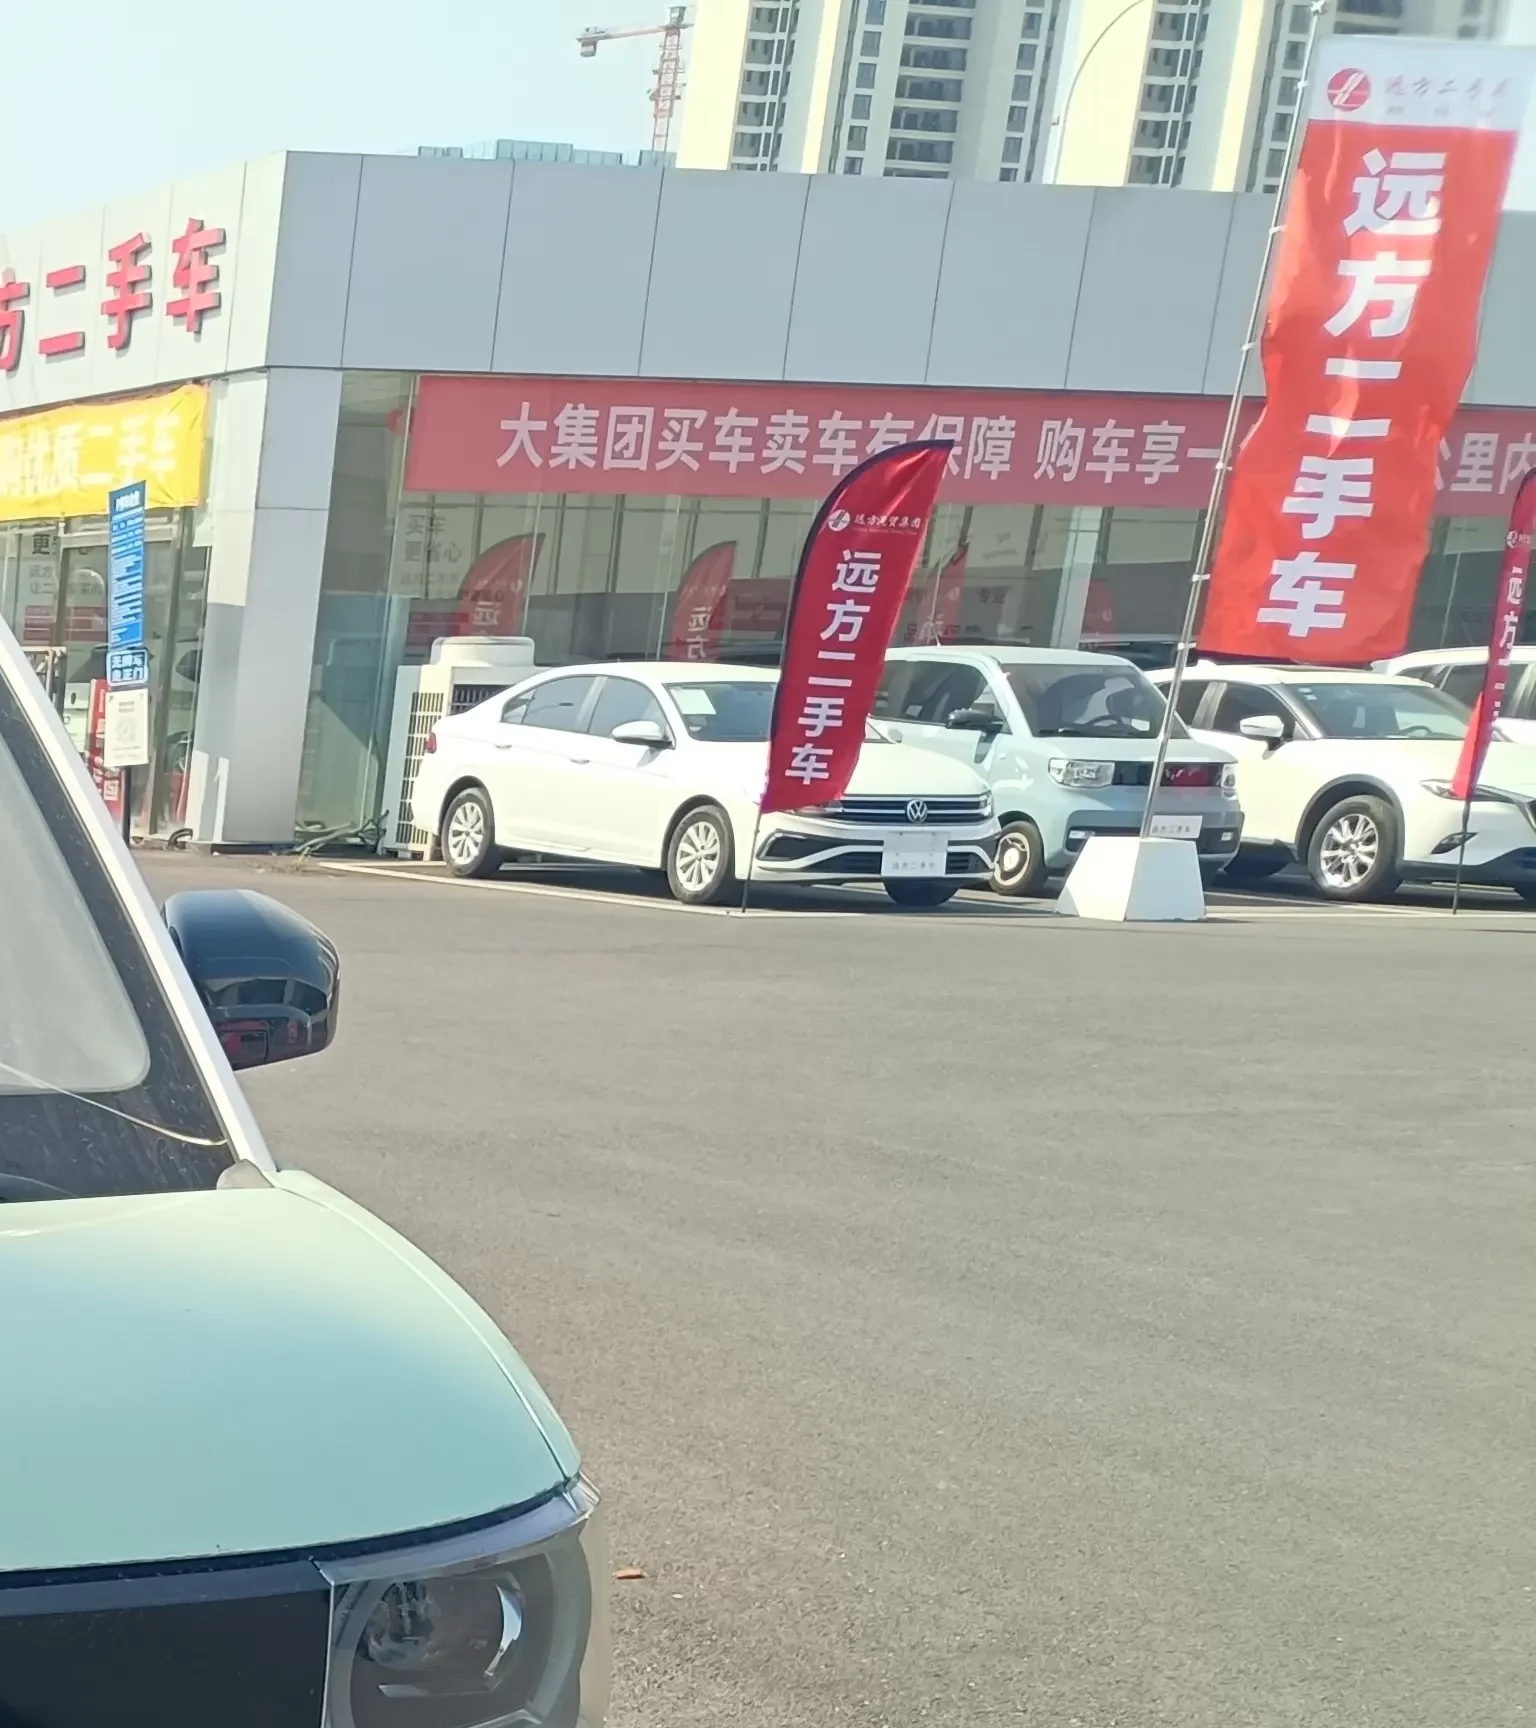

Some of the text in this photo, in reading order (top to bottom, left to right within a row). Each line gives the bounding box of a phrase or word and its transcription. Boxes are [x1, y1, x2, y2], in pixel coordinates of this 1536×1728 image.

[1254, 148, 1447, 638] 远方二手车
[785, 549, 882, 785] 远方二手车
